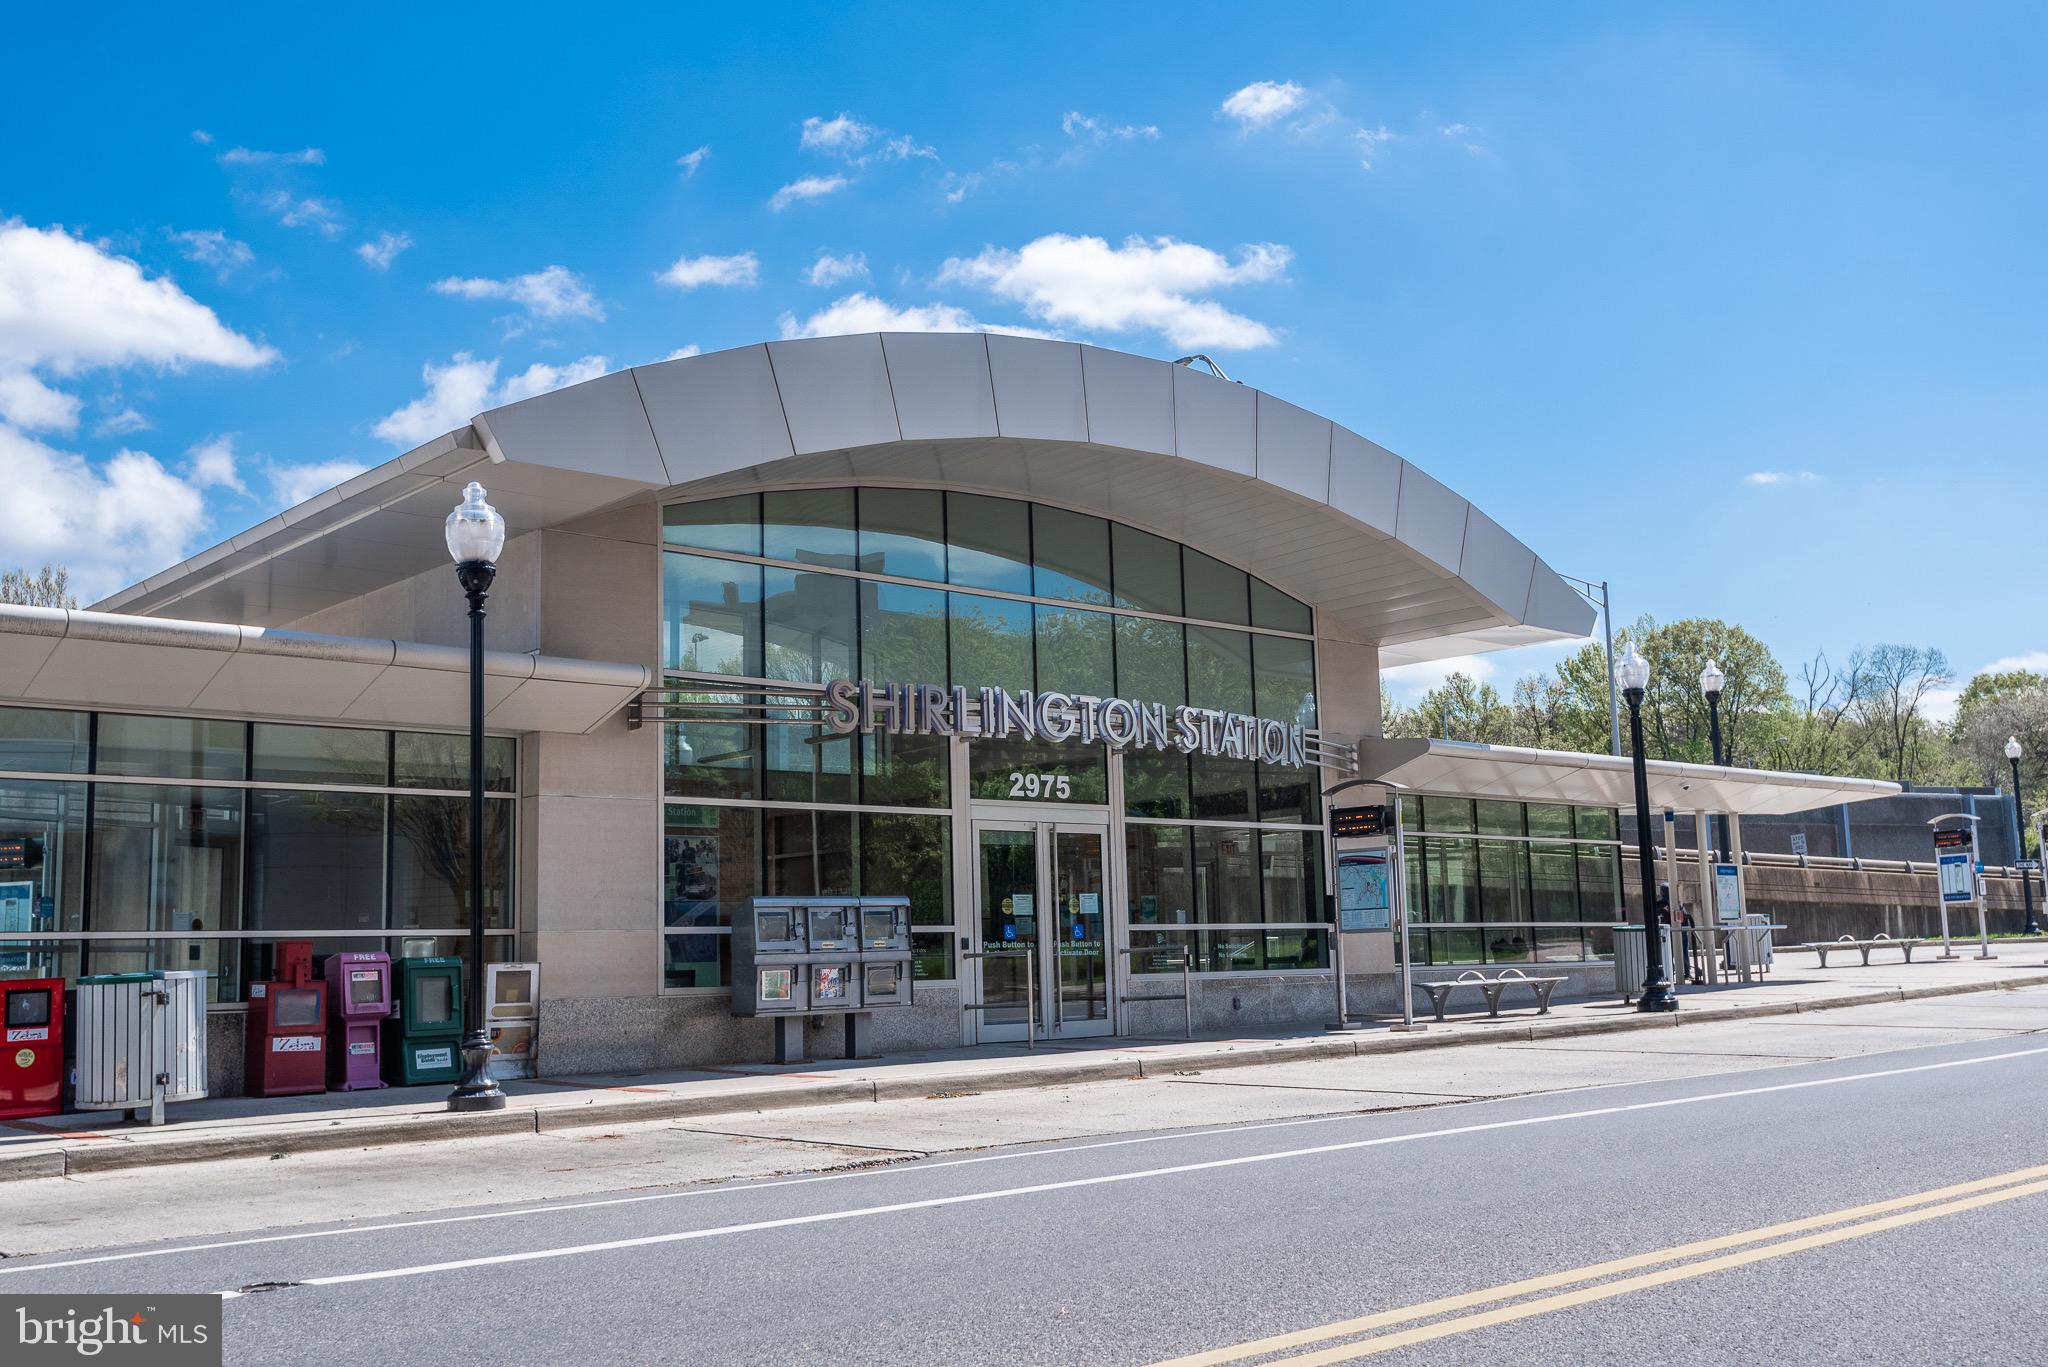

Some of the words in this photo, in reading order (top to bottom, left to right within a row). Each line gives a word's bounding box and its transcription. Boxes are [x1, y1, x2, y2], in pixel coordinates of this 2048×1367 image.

[825, 679, 1168, 751] SHIRLINGTON
[1173, 704, 1306, 769] STATION
[1009, 772, 1071, 799] 2975
[667, 806, 696, 817] Station
[1002, 940, 1026, 948] Button
[353, 953, 377, 961] FREE
